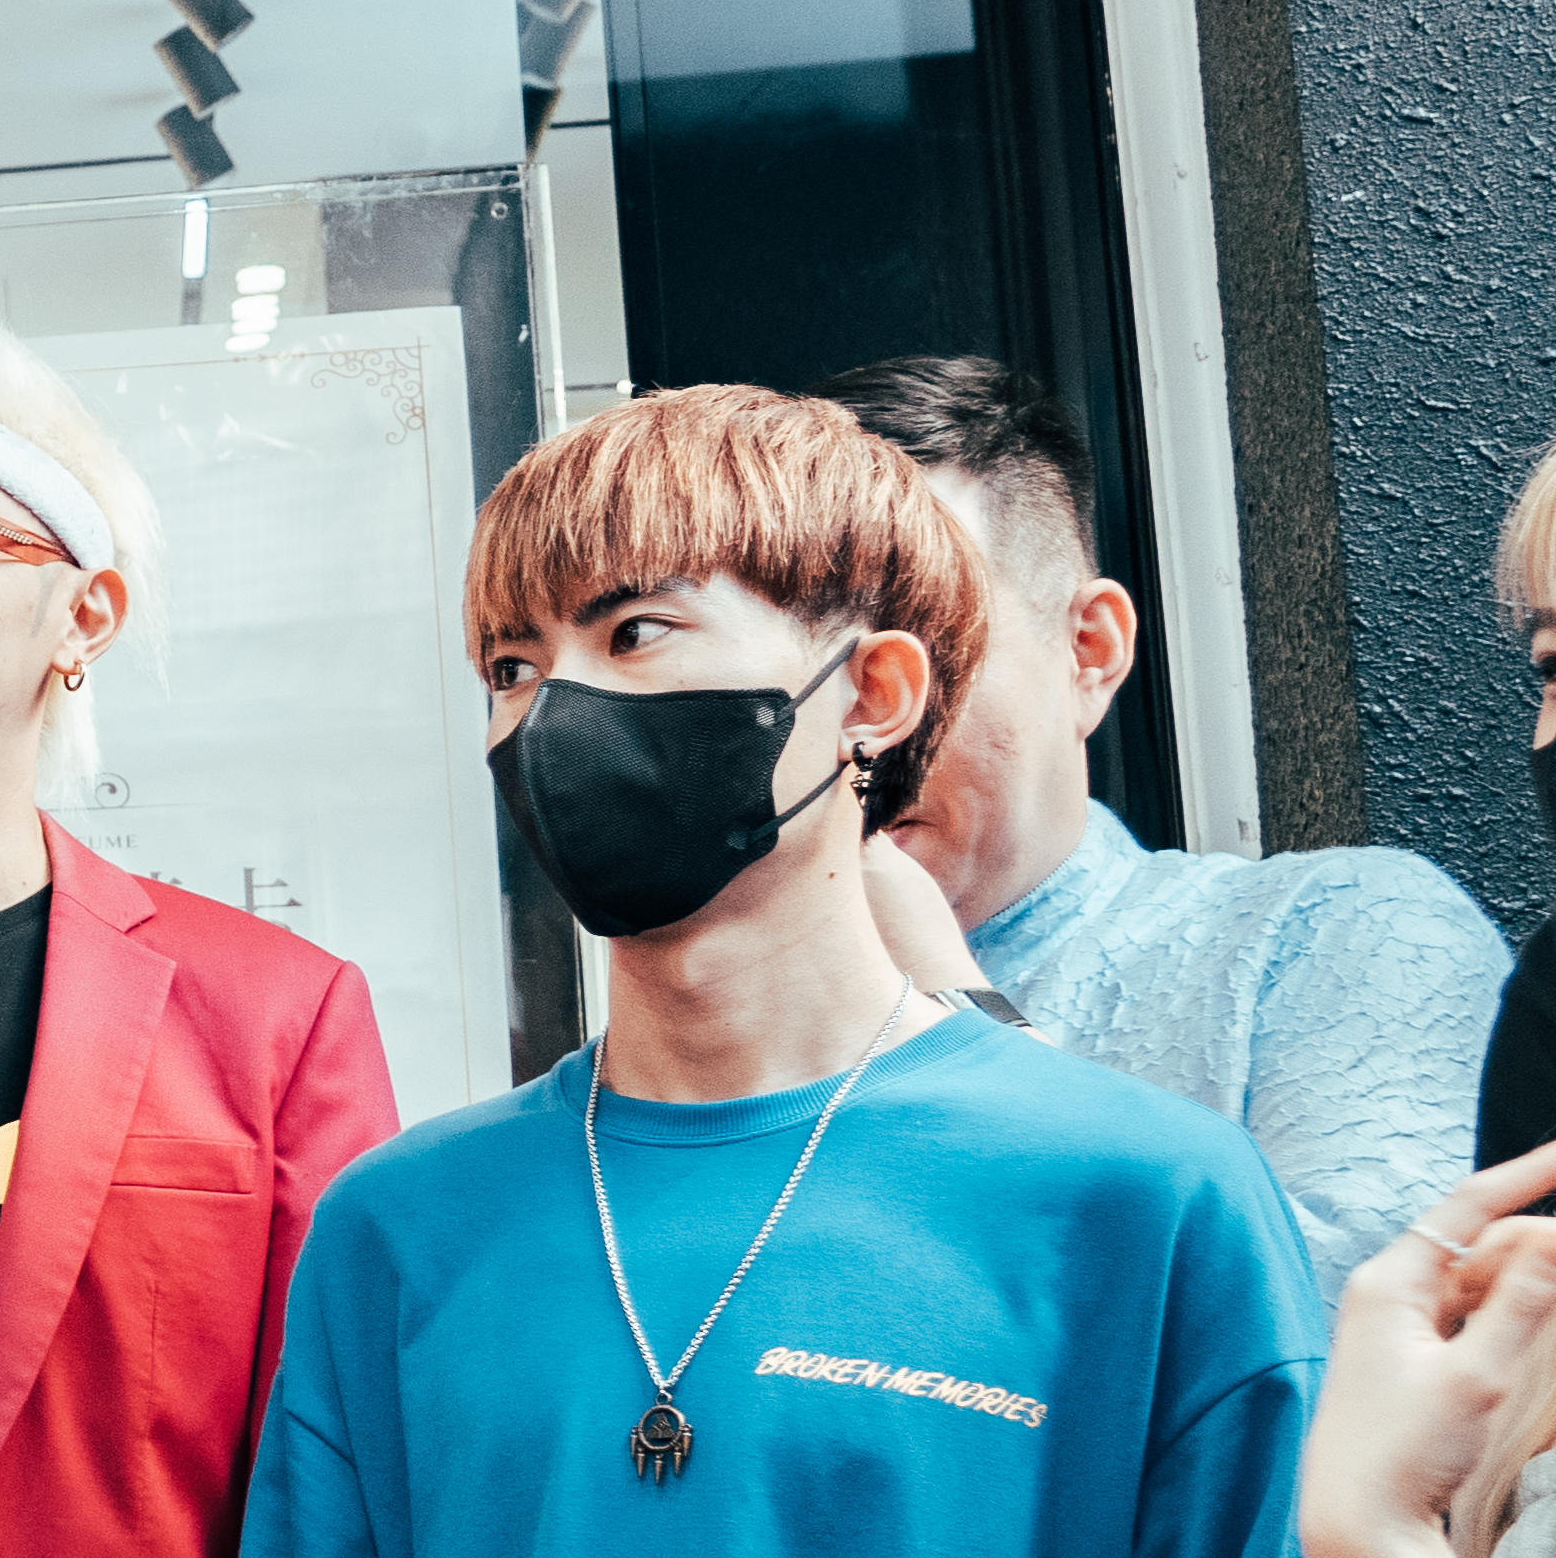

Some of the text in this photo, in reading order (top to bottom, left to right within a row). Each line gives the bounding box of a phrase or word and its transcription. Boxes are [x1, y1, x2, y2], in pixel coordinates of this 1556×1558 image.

[78, 834, 139, 851] UME
[754, 1346, 1048, 1428] BROKEN MEMORIES
